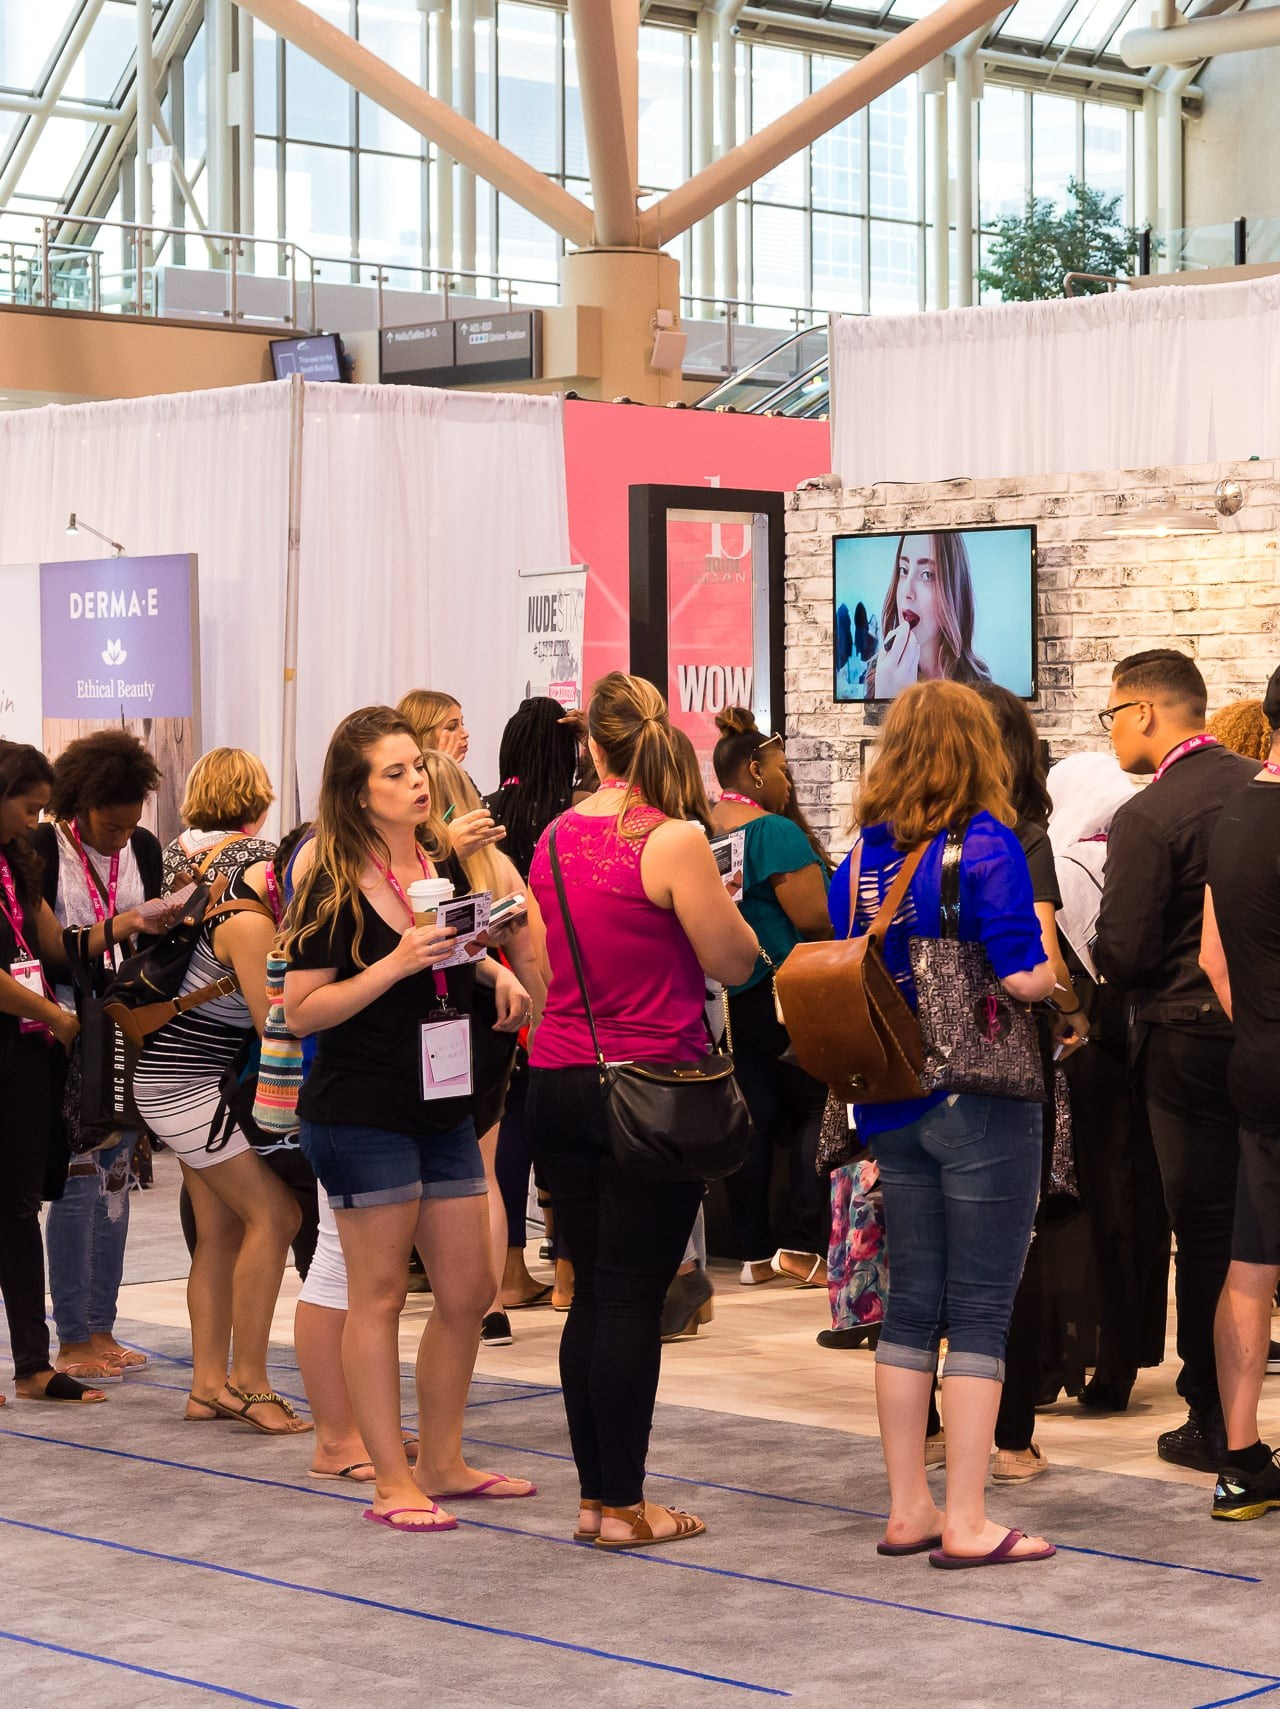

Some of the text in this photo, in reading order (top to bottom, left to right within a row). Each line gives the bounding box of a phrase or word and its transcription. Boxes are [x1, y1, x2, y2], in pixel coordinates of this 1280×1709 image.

[77, 680, 155, 701] Ethical Beauty
[677, 665, 752, 713] WOW
[114, 1077, 125, 1112] MARC
